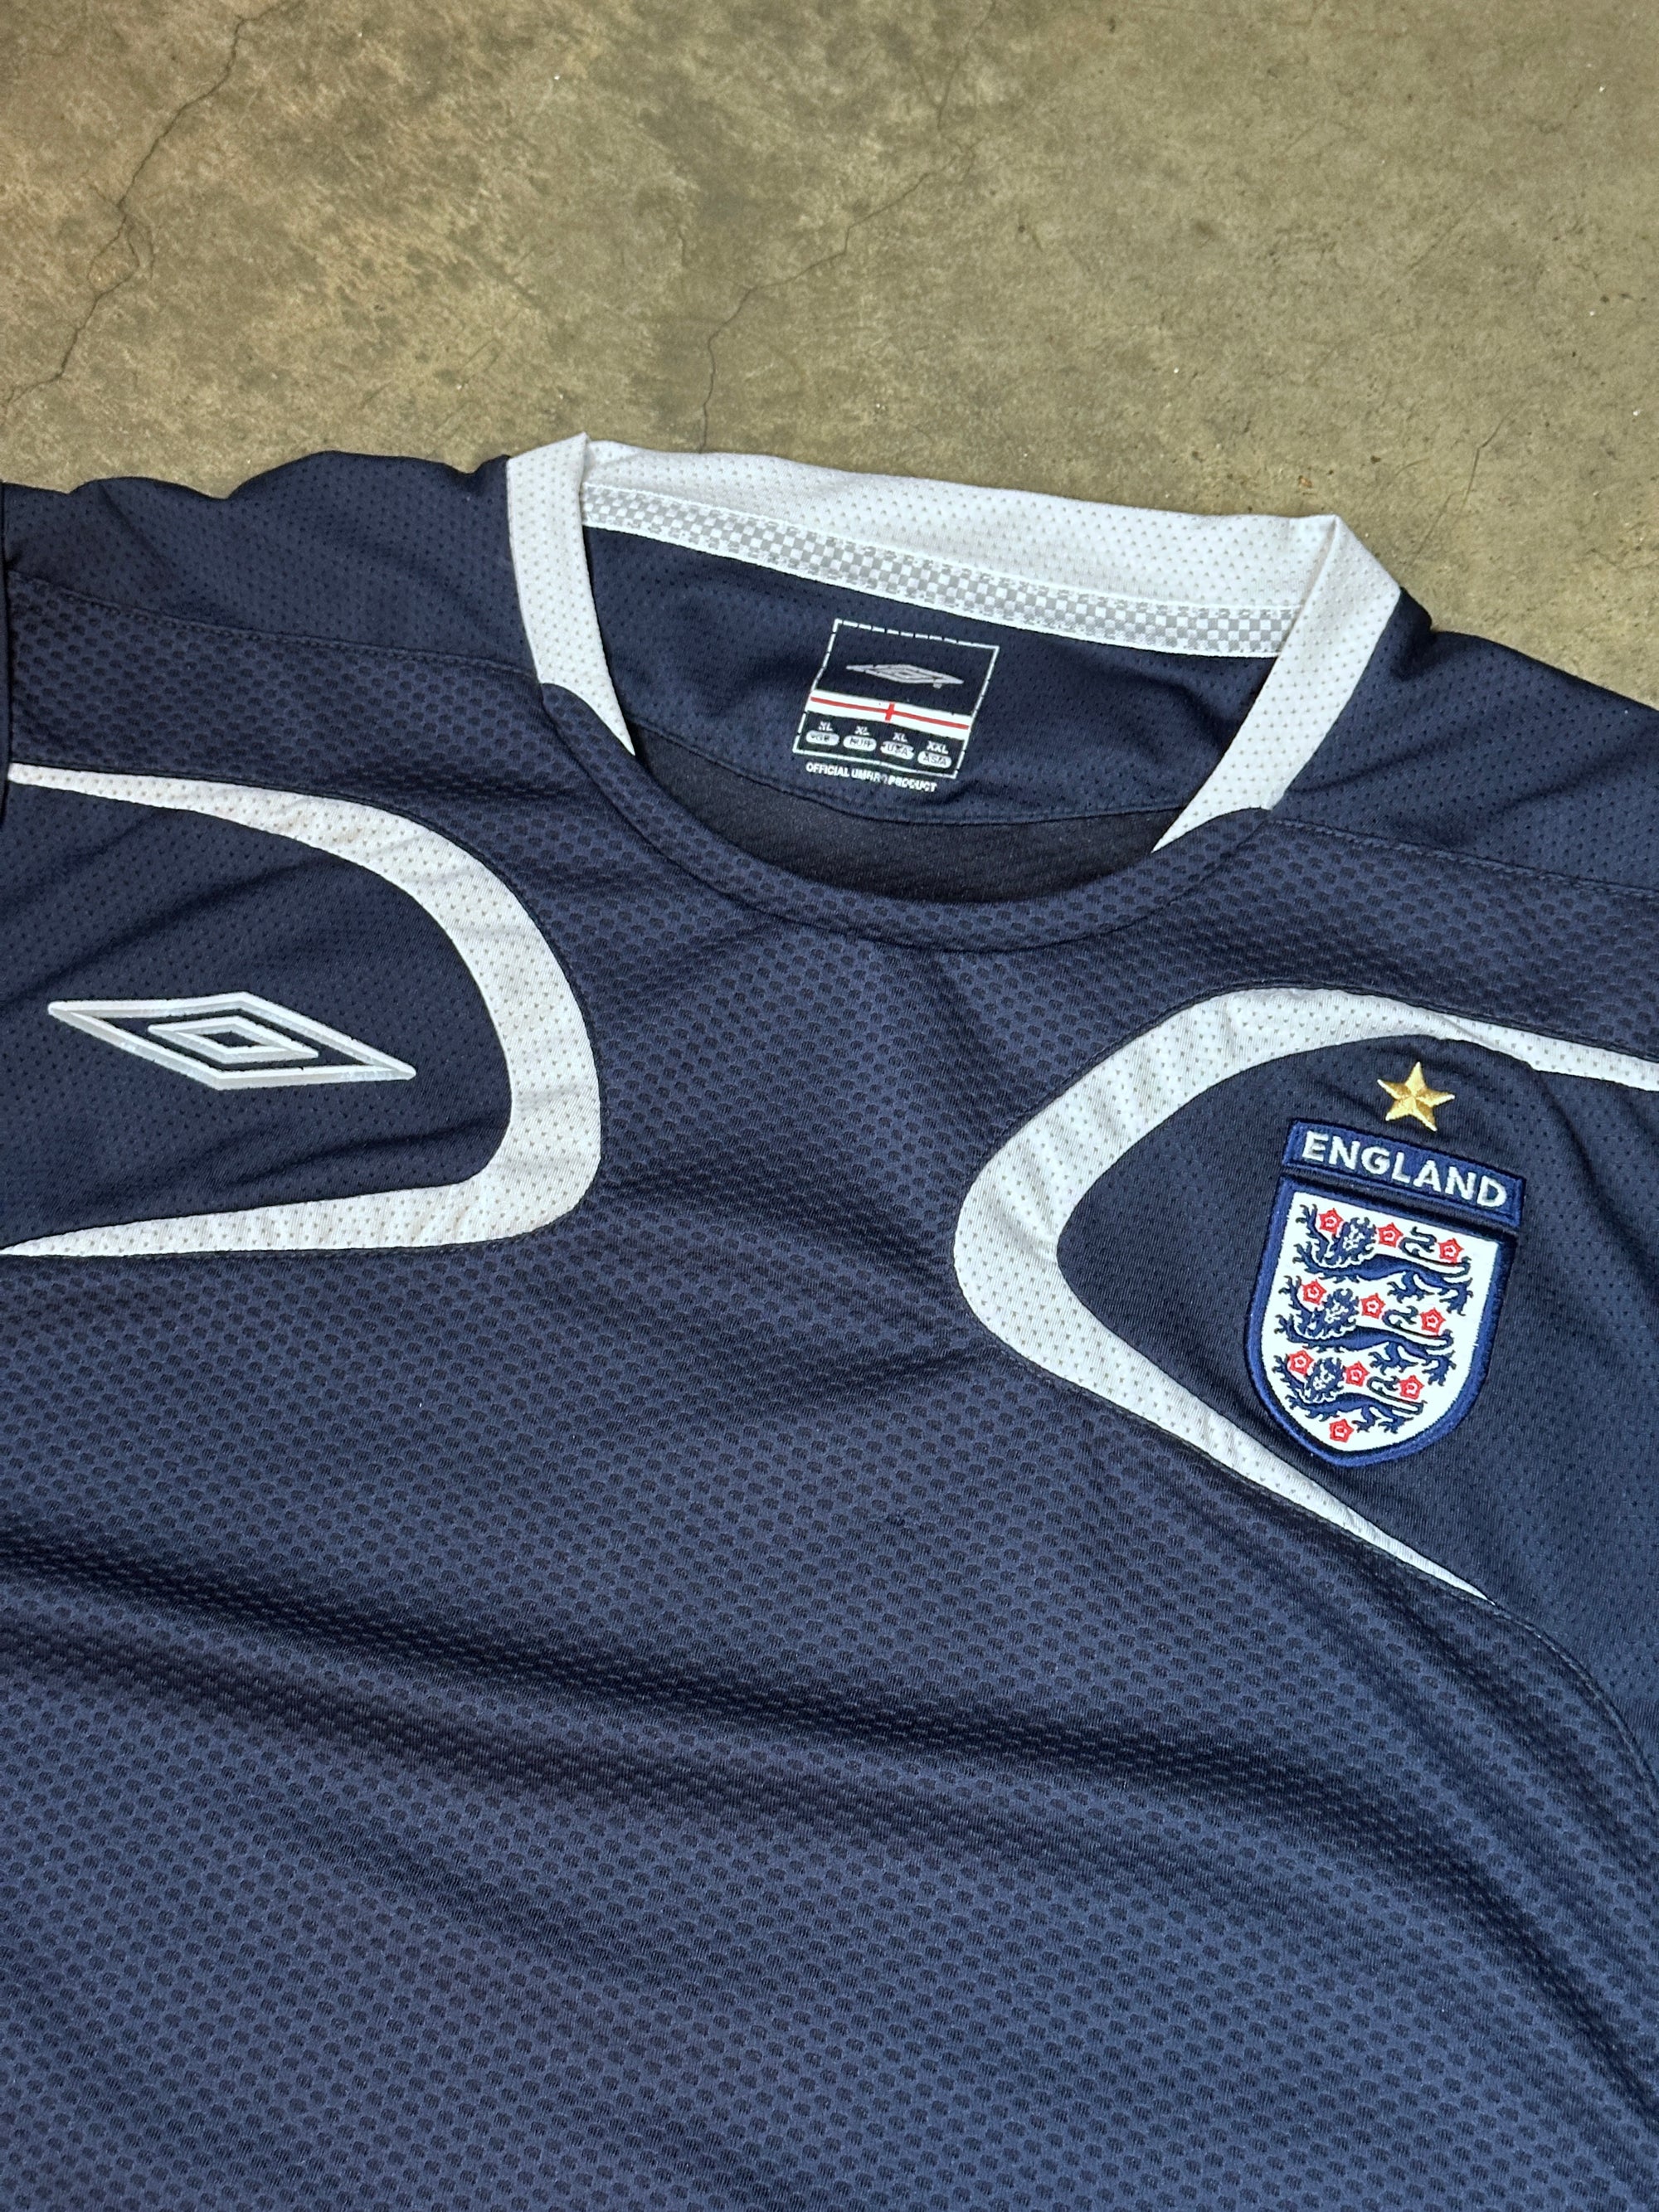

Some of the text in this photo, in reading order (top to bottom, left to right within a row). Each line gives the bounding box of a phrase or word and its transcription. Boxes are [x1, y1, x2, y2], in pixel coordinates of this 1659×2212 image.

[854, 726, 870, 736] XL
[893, 732, 908, 742] XL
[927, 741, 948, 755] XXL
[805, 761, 850, 777] OFFICIAL
[888, 775, 937, 792] PRODUCT
[1301, 1130, 1506, 1208] ENGLAND
